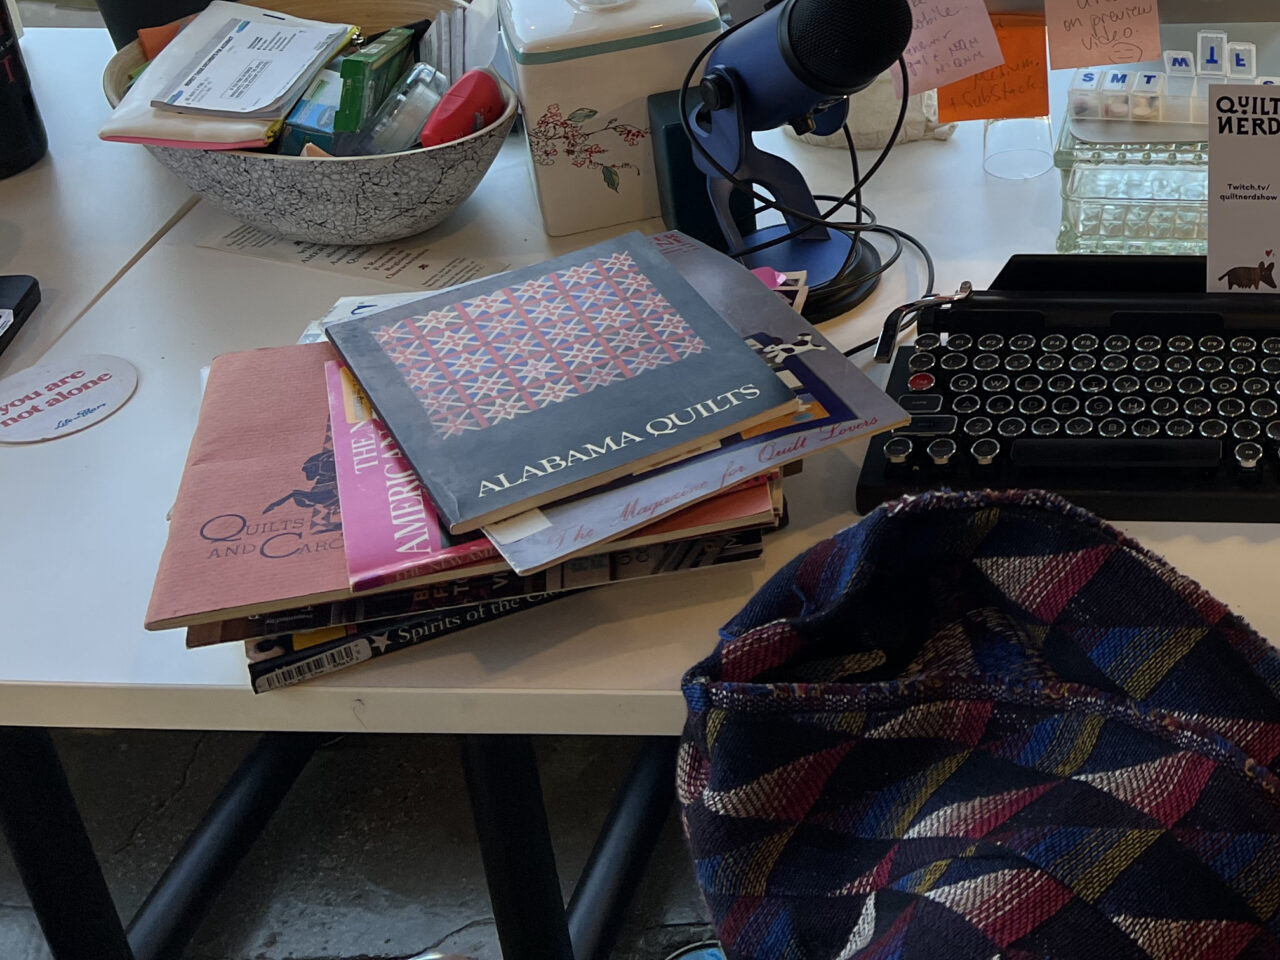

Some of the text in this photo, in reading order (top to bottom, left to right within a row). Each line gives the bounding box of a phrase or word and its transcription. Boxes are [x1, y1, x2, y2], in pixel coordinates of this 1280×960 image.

[1063, 4, 1153, 40] on preview
[1082, 72, 1156, 84] S M T
[1219, 193, 1278, 202] quiltnerdshow
[1226, 184, 1270, 192] Twitch.tv/
[44, 370, 86, 392] are
[0, 404, 44, 428] not
[46, 372, 112, 408] alone
[352, 438, 379, 474] THE
[477, 384, 761, 498] ALABAMA QUILTS
[548, 525, 594, 550] The
[719, 461, 746, 489] for
[758, 436, 808, 465] Quilt
[818, 416, 879, 442] Lovers
[208, 543, 256, 560] AND
[398, 596, 520, 644] Spirits of the
